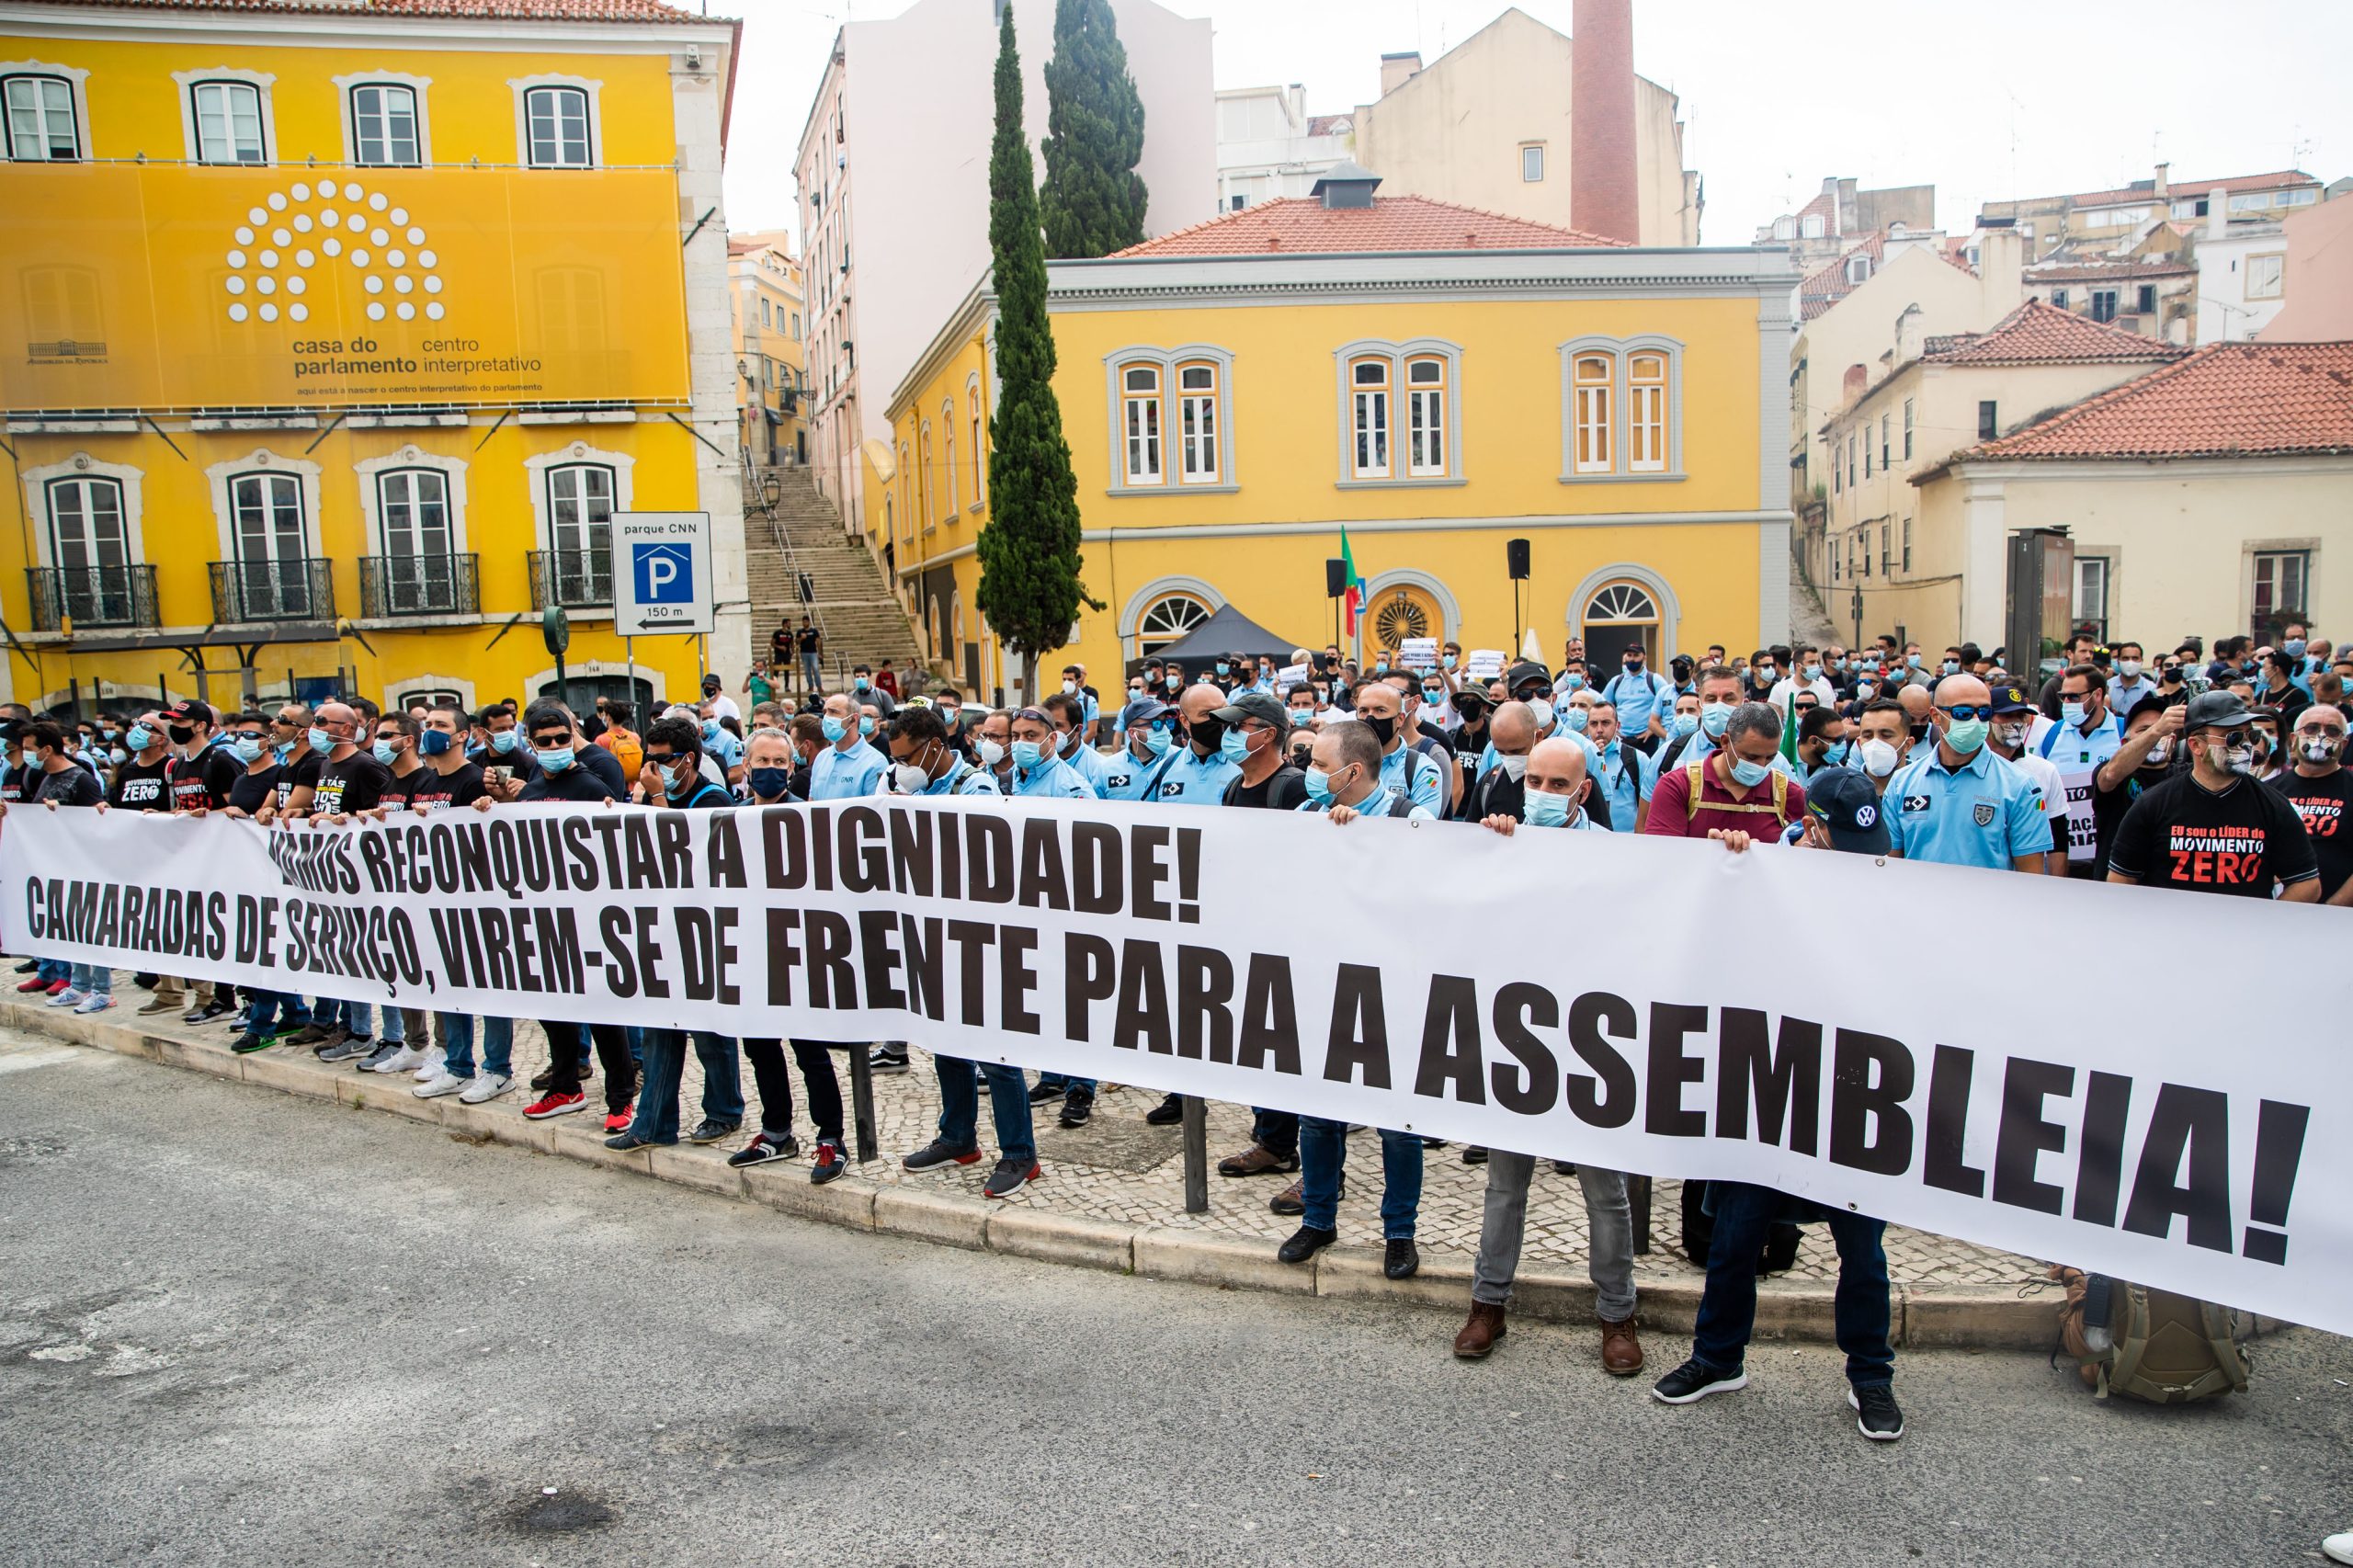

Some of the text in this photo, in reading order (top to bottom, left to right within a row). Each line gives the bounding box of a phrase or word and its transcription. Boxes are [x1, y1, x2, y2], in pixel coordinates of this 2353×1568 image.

[292, 336, 378, 354] casa do
[422, 337, 480, 352] centro
[294, 357, 417, 379] parlamento
[423, 356, 542, 376] interpretativo
[297, 386, 317, 396] aqui
[318, 385, 338, 395] está
[347, 386, 378, 394] nascer
[388, 385, 417, 393] centro
[419, 384, 478, 394] interpretativo
[480, 383, 491, 392] do
[494, 383, 542, 392] parlamento
[624, 523, 697, 535] parque CNN
[648, 556, 677, 599] P
[647, 607, 683, 617] 150 m
[1611, 774, 1626, 784] GR
[121, 784, 160, 802] ZERO
[2171, 824, 2266, 839] EU sou o LÍDER do
[2170, 836, 2264, 854] MOVIMENTO
[359, 810, 693, 900] RECONQUISTAR
[708, 810, 748, 889] A
[762, 806, 1201, 925] DIGNIDADE!
[2169, 850, 2262, 883] ZERO
[27, 876, 2311, 1267] CAMARADAS DE SERVIÇO, VIREM-SE DE FRENTE PARA A ASSEMBLEIA!
